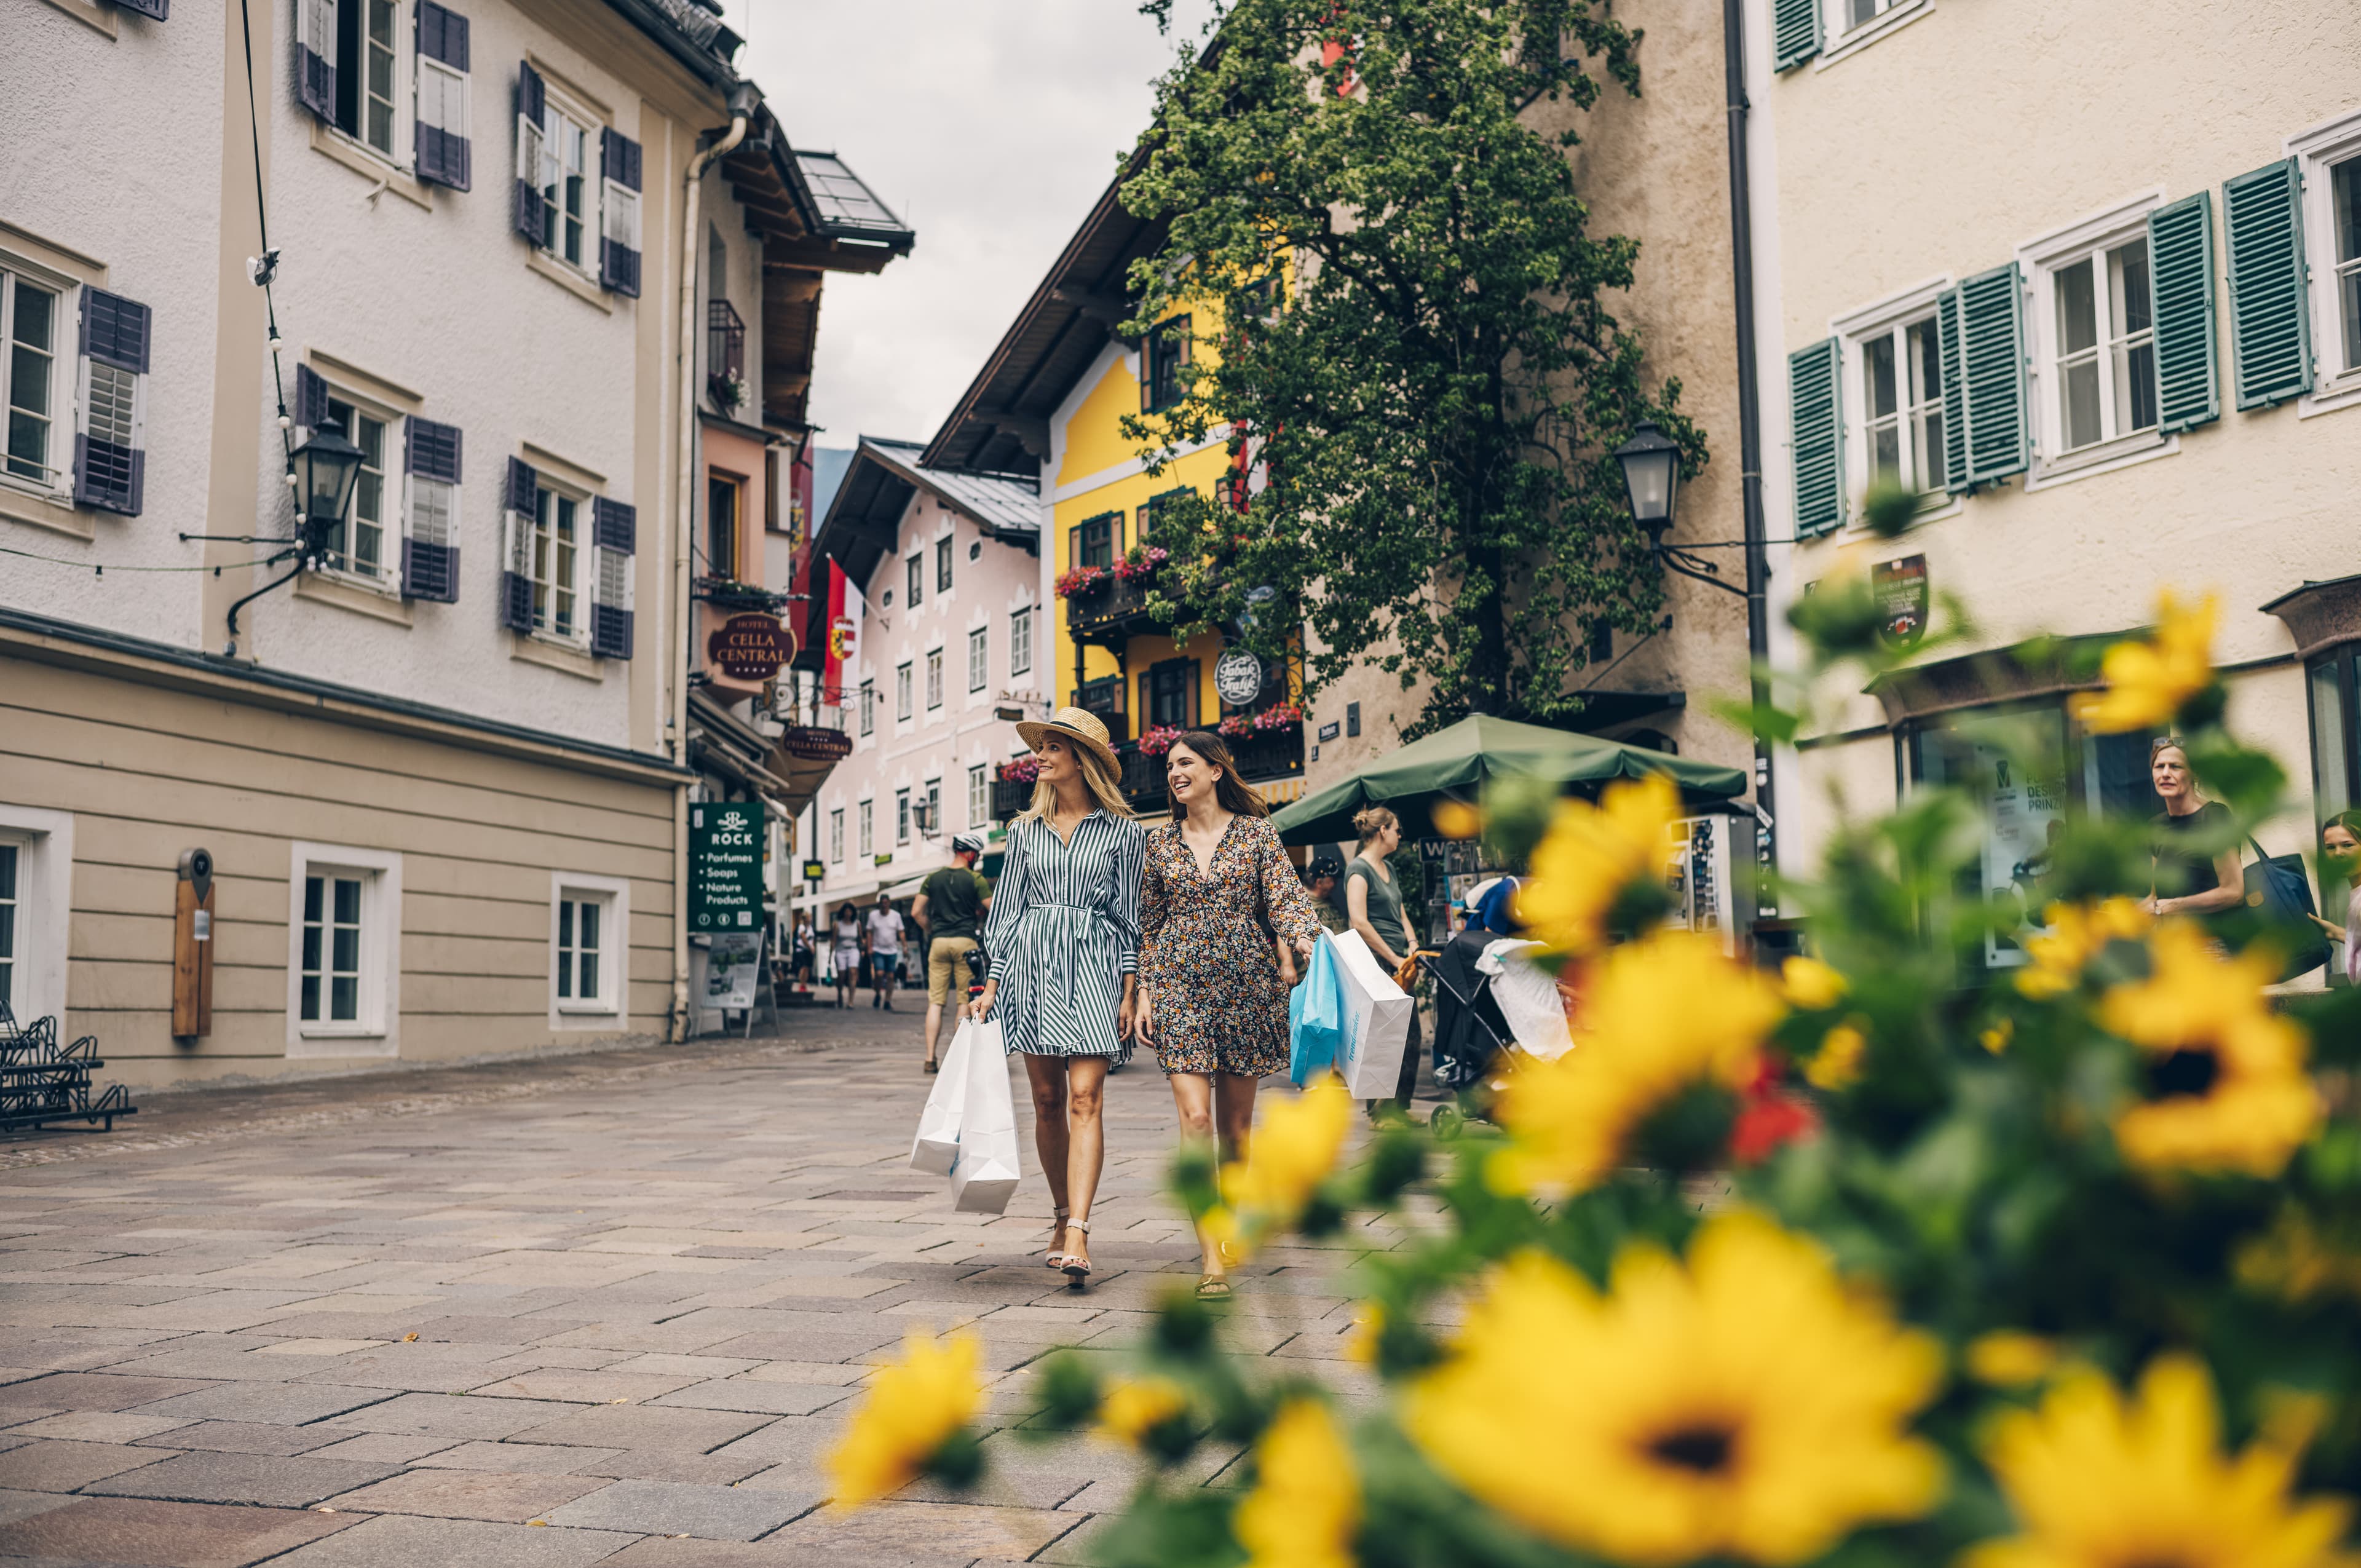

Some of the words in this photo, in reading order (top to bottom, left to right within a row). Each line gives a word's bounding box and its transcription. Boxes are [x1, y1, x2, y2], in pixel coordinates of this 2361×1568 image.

[737, 620, 770, 629] HOTEL
[729, 633, 775, 646] CELLA
[717, 649, 786, 662] CENTRAL
[1219, 658, 1257, 679] Tabak
[1219, 676, 1258, 695] Trafik
[711, 833, 753, 845] ROCK
[707, 852, 753, 863] Parfumes
[707, 867, 738, 879] Soaps
[706, 882, 742, 892] Nature
[706, 895, 748, 905] Products
